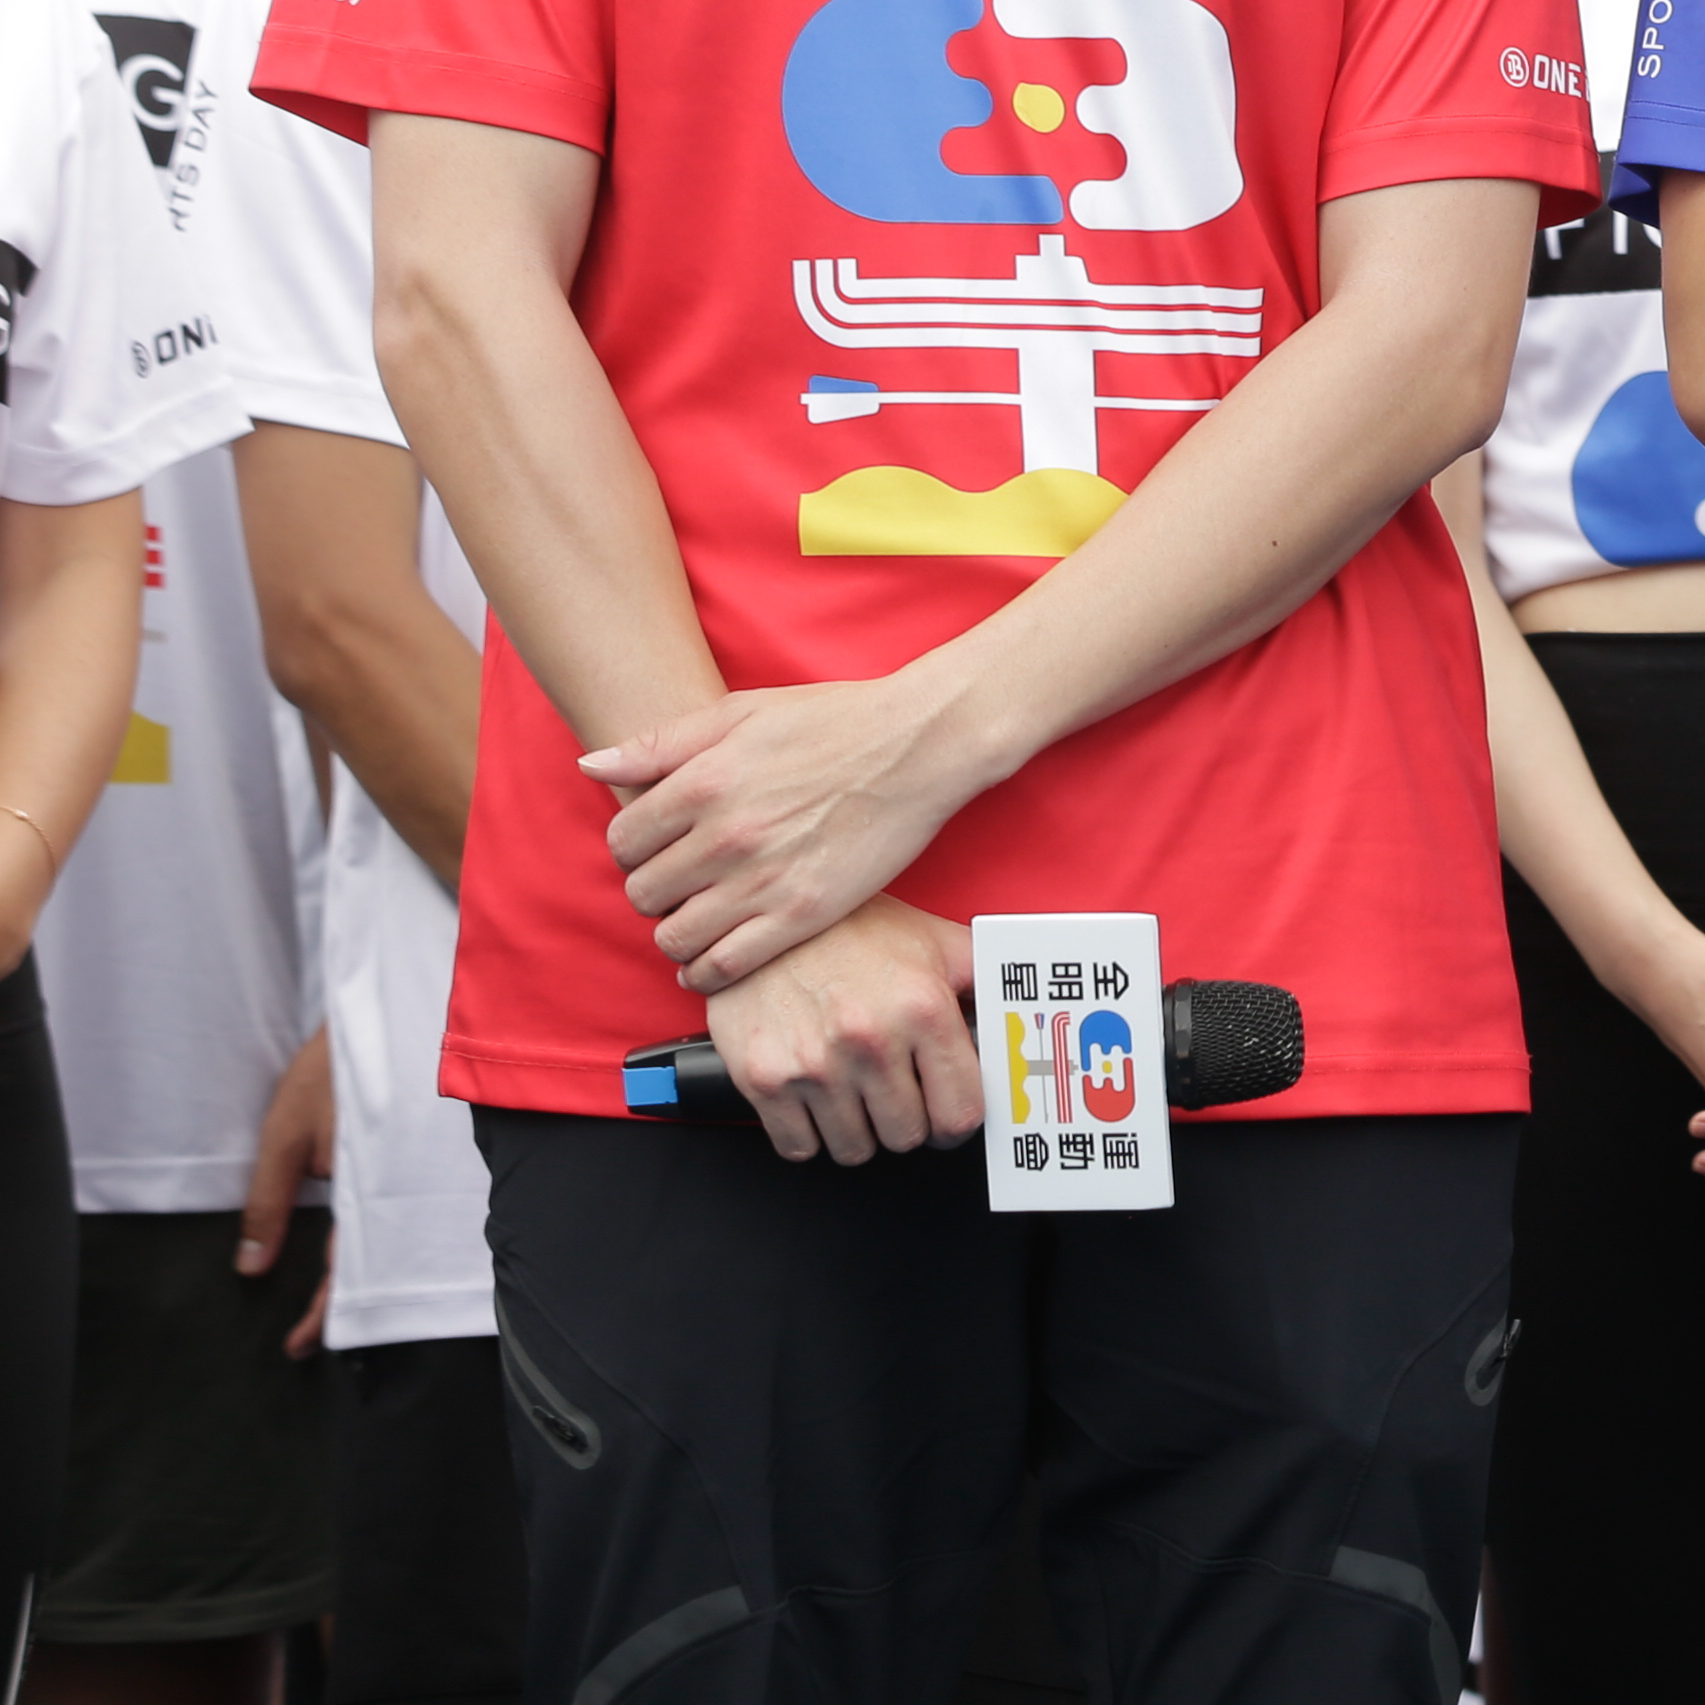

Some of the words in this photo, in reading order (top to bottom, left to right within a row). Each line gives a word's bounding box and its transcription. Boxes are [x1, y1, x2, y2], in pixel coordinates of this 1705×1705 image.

[184, 79, 219, 154] DAY
[1000, 961, 1130, 1002] 全明星
[1013, 1131, 1139, 1172] 運動會
